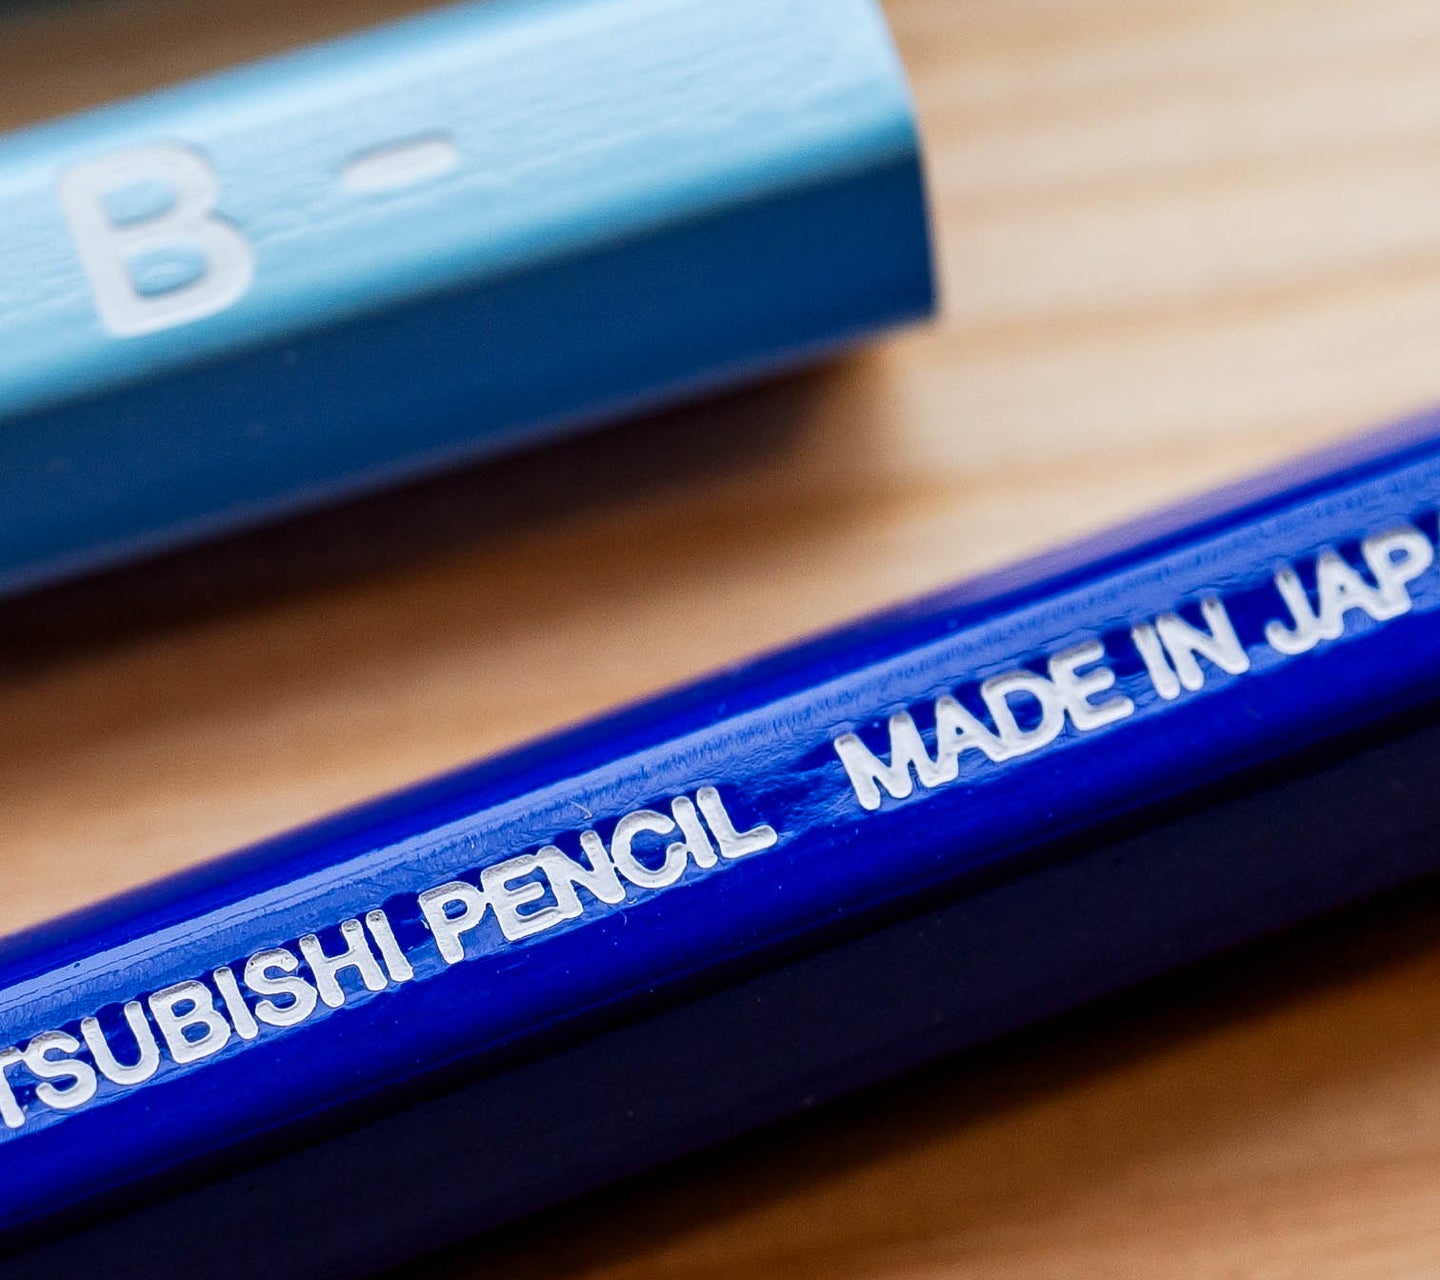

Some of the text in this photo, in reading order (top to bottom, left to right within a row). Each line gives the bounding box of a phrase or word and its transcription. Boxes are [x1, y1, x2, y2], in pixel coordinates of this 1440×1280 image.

[58, 138, 255, 338] B
[417, 785, 777, 964] PENCIL
[832, 640, 1135, 811] MADE
[1131, 597, 1251, 700] IN
